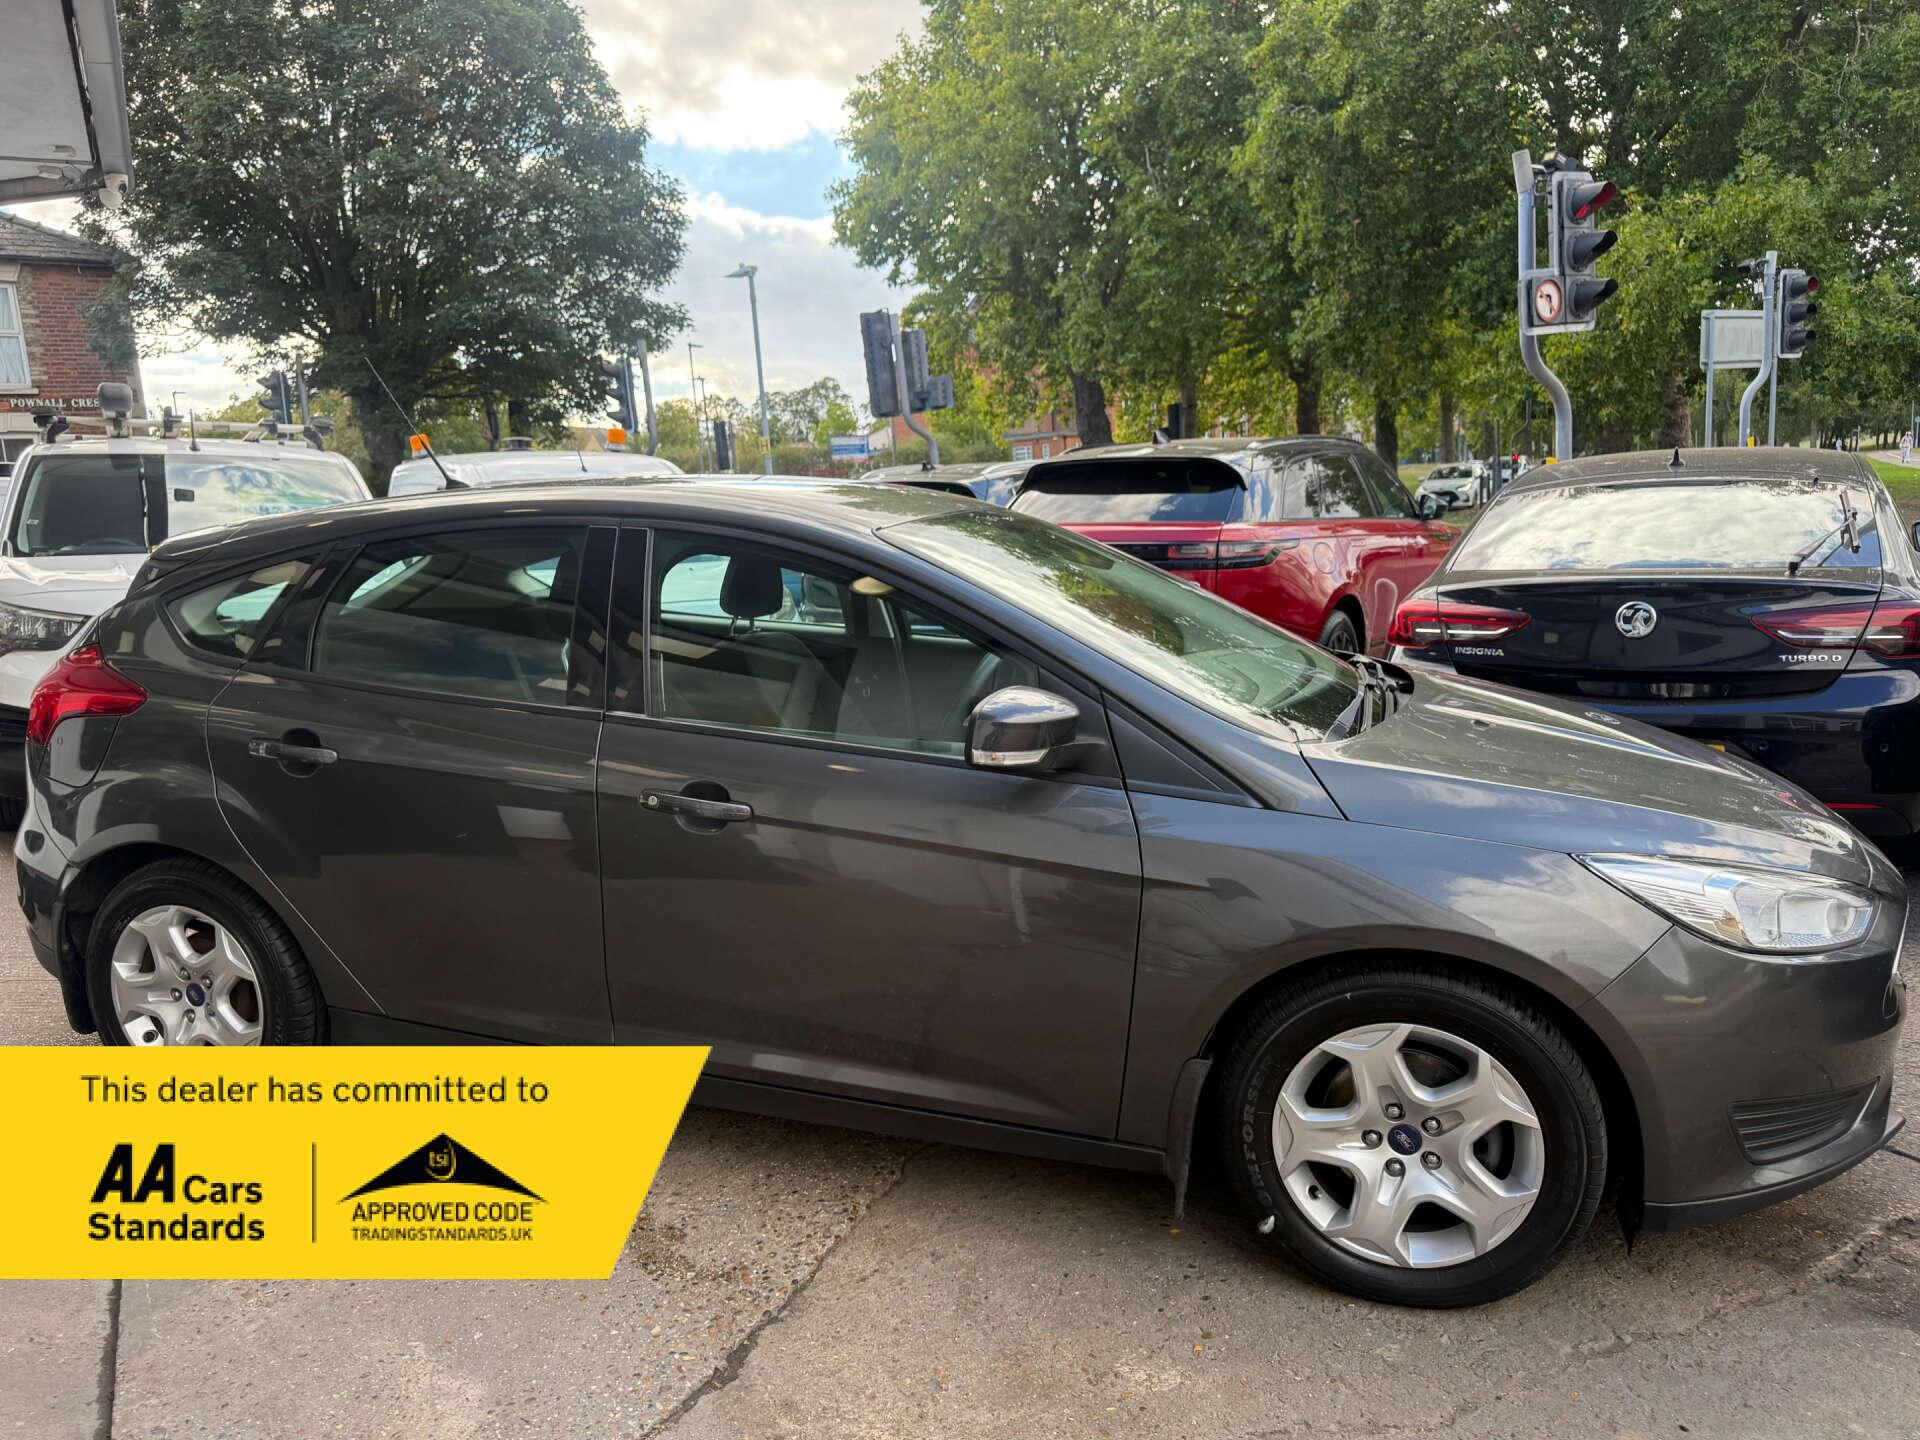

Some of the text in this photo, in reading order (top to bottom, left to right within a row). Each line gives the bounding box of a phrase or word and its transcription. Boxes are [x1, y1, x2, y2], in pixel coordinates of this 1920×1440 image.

[10, 398, 100, 408] POWNALL CRES
[1454, 646, 1505, 657] INSIGNIA
[1778, 654, 1842, 663] TURBO D
